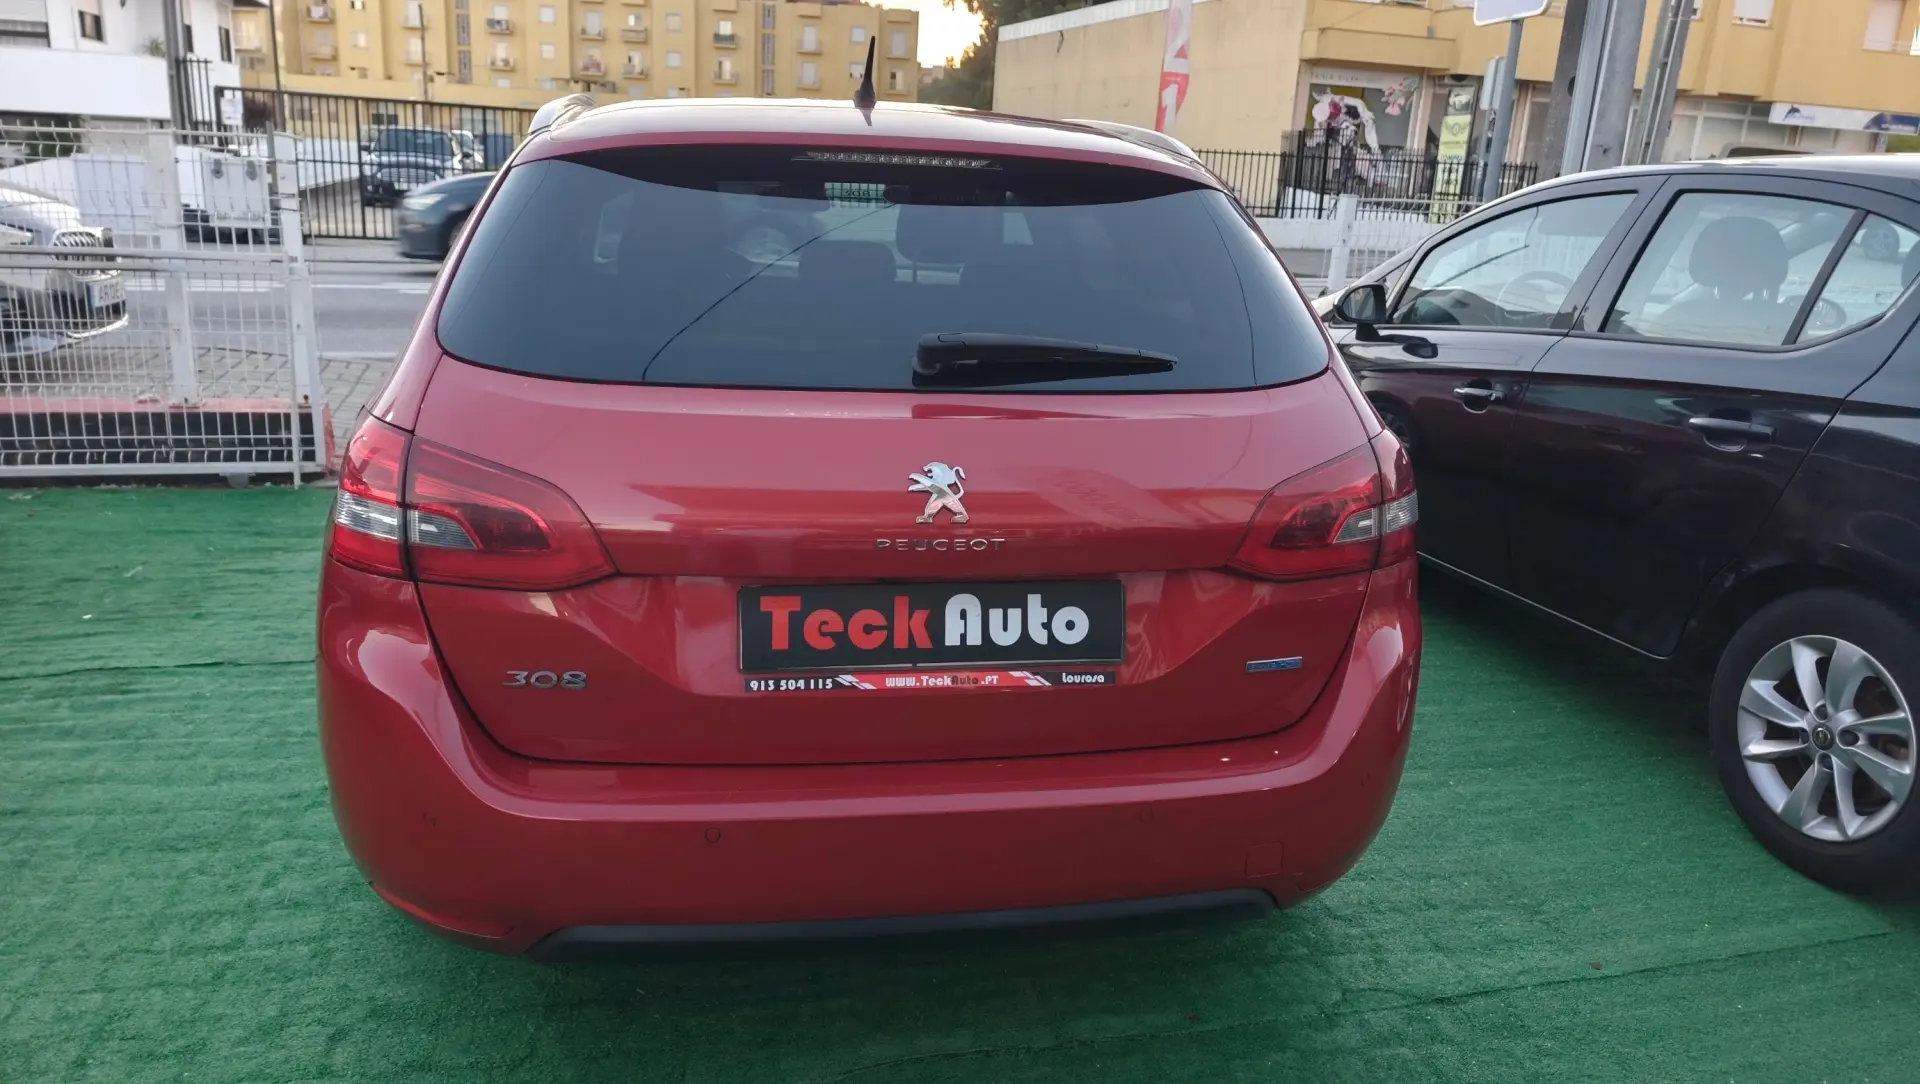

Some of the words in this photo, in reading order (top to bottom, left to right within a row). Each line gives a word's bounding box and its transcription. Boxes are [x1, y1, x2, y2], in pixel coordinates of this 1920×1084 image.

[874, 537, 1007, 552] PEUGEOT
[760, 596, 934, 650] Teck
[944, 593, 1090, 646] Auto
[501, 670, 588, 689] 308
[749, 679, 775, 691] 913
[779, 678, 805, 690] 504
[809, 677, 833, 689] 115
